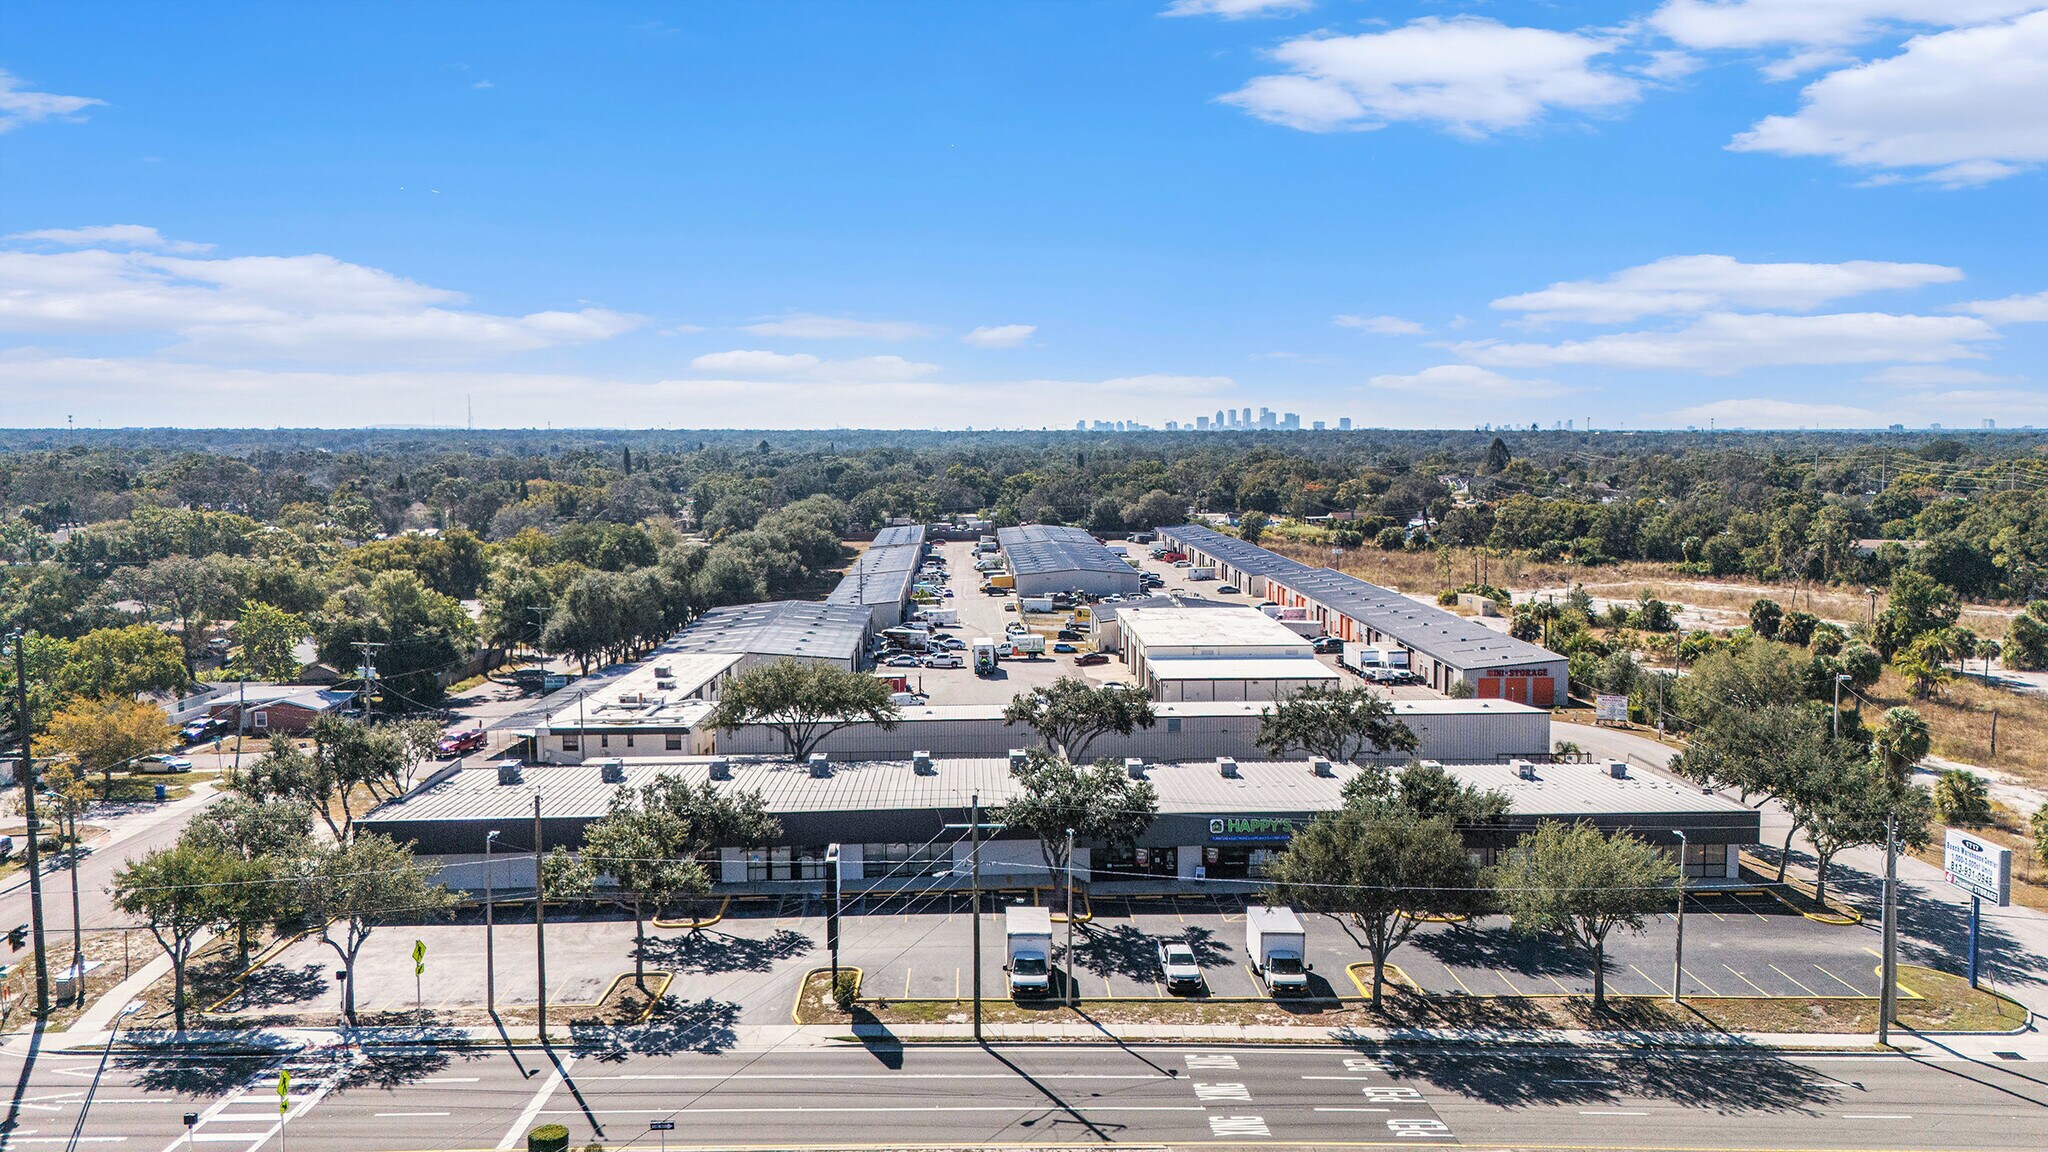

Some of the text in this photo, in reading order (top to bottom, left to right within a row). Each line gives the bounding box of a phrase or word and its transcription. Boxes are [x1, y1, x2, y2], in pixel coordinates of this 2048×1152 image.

[1227, 818, 1293, 833] HAPPY'S
[1362, 1087, 1427, 1103] PED
[1208, 1116, 1272, 1137] XING
[1386, 1119, 1455, 1137] PED
